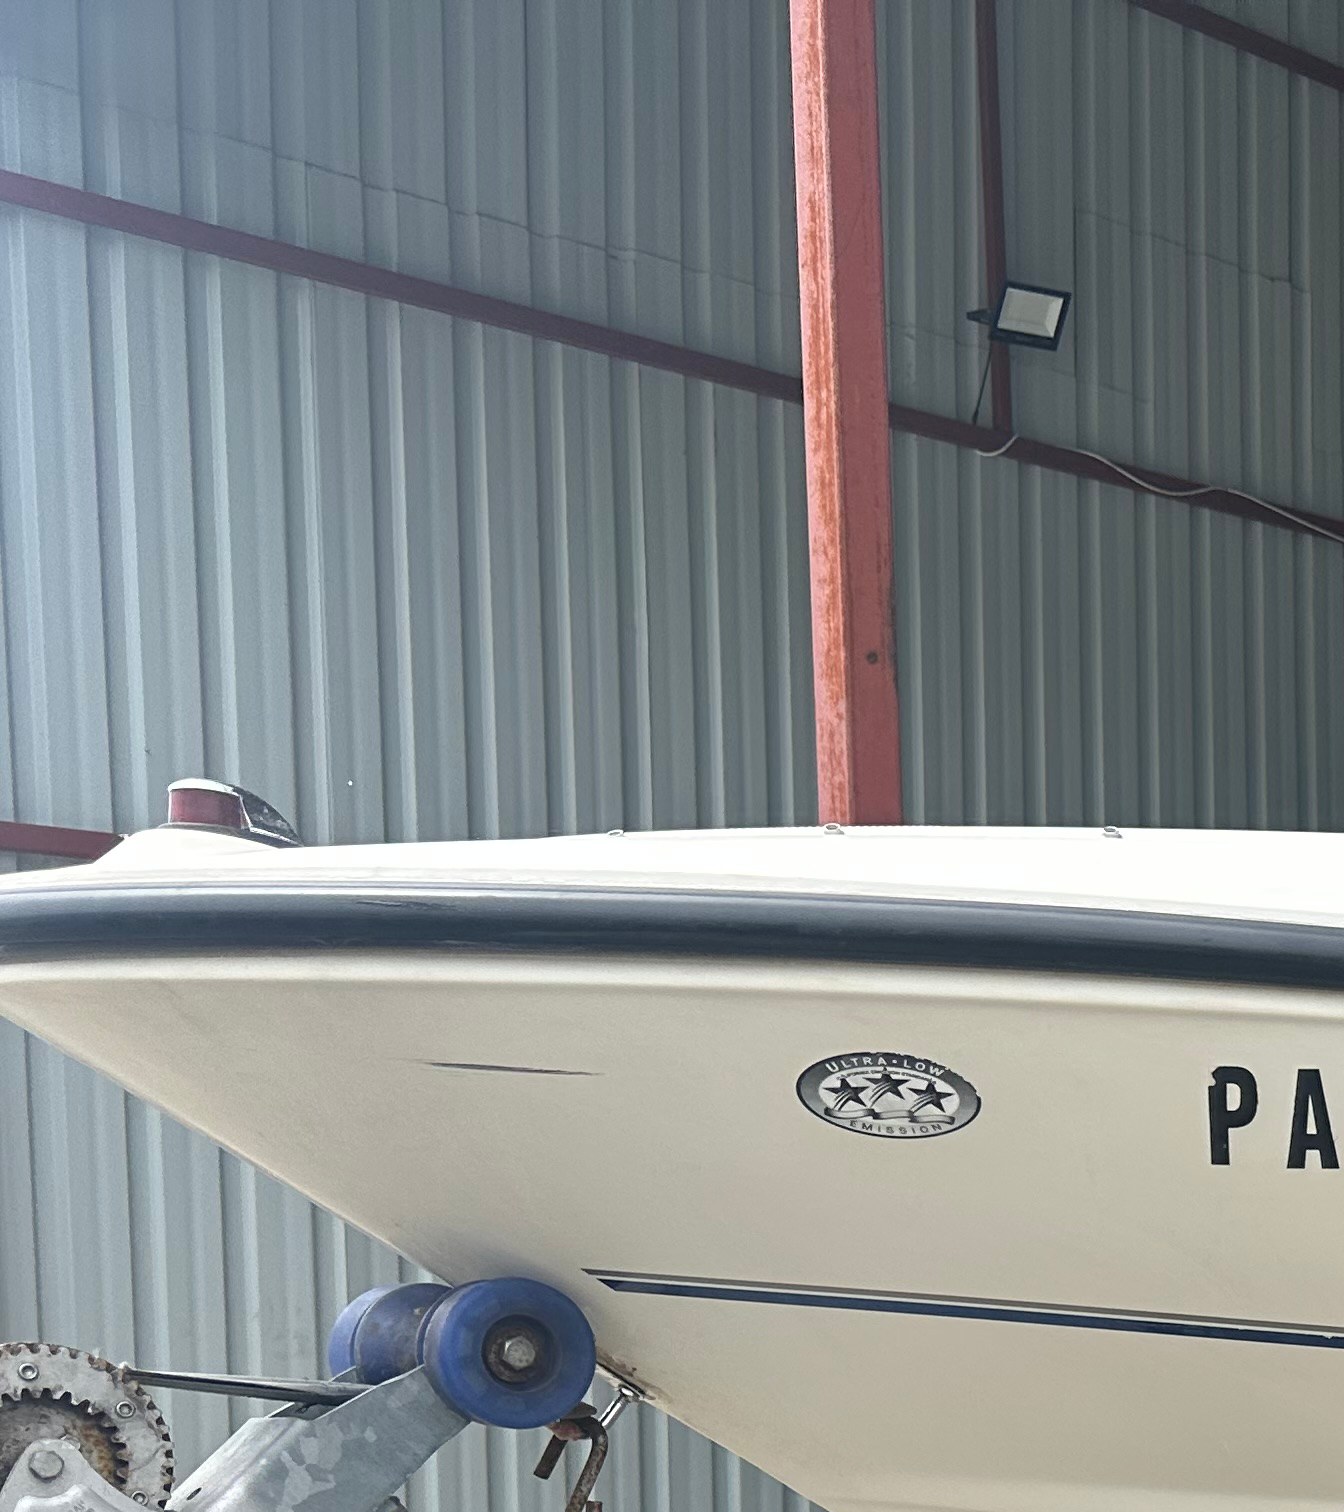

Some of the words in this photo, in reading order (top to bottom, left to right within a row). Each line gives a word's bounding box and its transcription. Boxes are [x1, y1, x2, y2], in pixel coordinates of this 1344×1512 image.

[826, 1056, 887, 1073] ULTRA
[903, 1059, 946, 1077] LOW
[850, 1119, 942, 1135] EMISSION
[1208, 1065, 1340, 1169] PA
